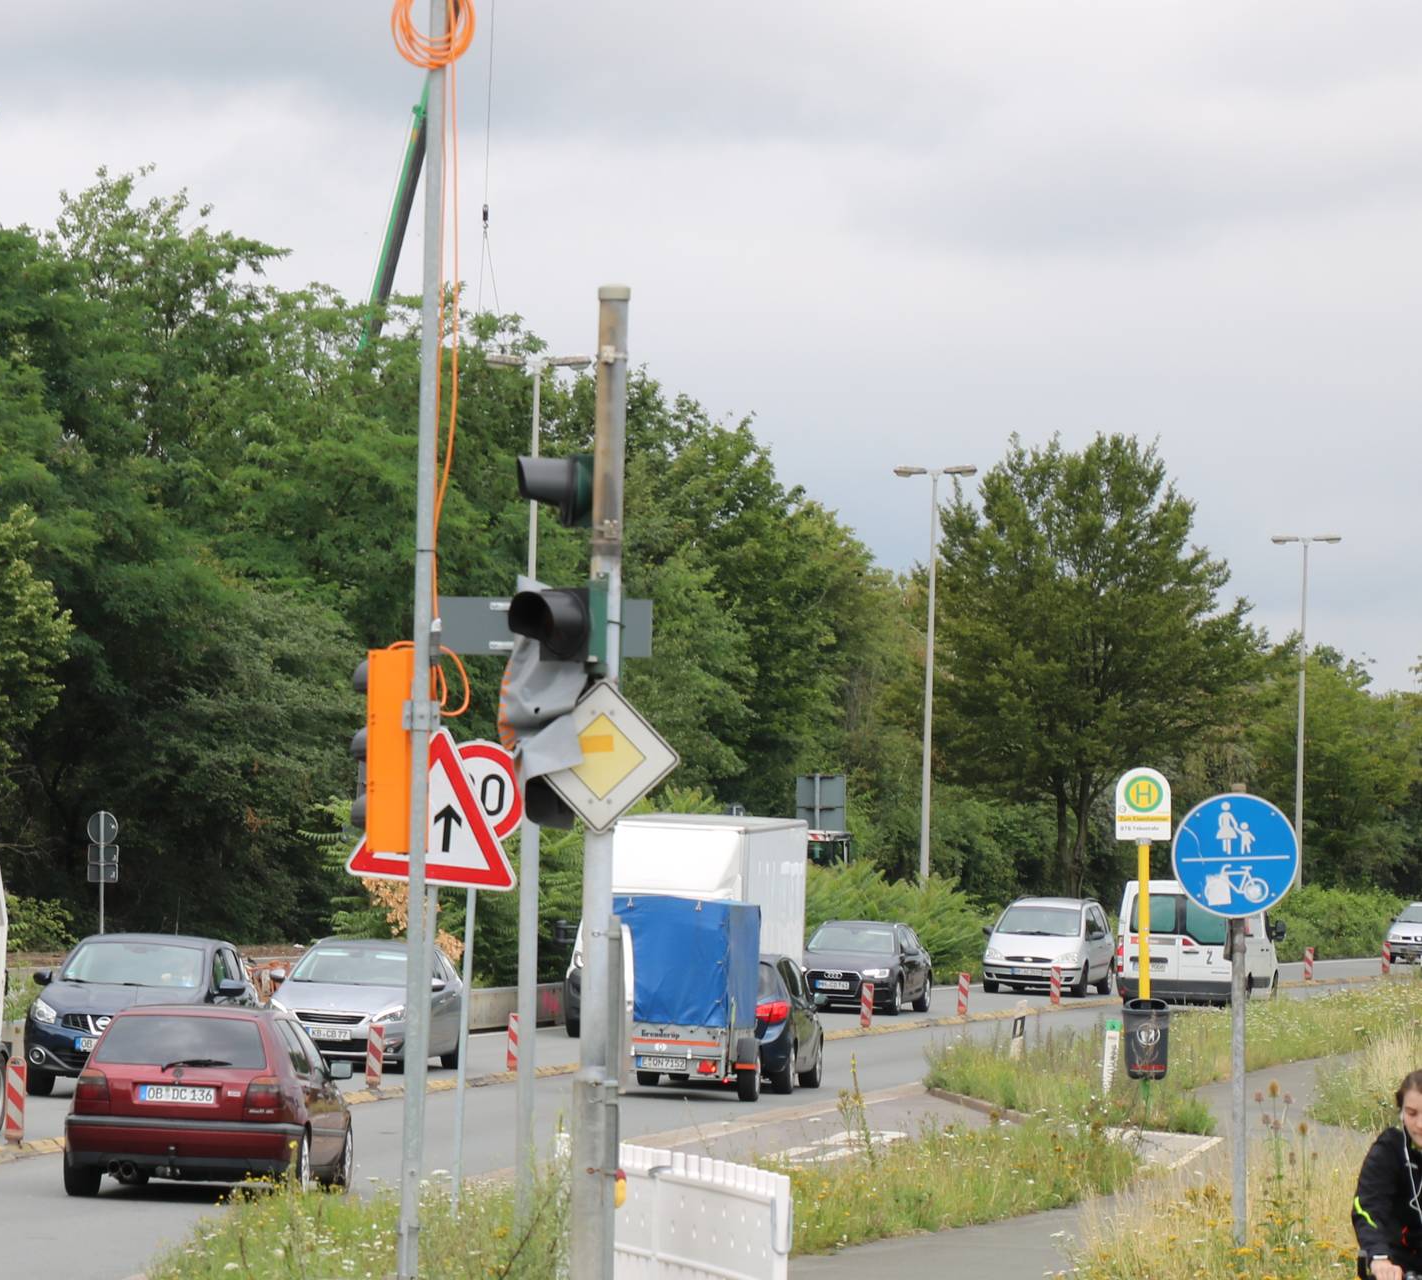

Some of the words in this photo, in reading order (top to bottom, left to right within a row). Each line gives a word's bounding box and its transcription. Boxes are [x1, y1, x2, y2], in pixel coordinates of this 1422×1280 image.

[468, 772, 506, 817] 0
[1136, 783, 1152, 805] H
[81, 1039, 93, 1048] OB
[148, 1087, 163, 1099] OB
[171, 1088, 188, 1100] DC
[190, 1089, 213, 1102] 136
